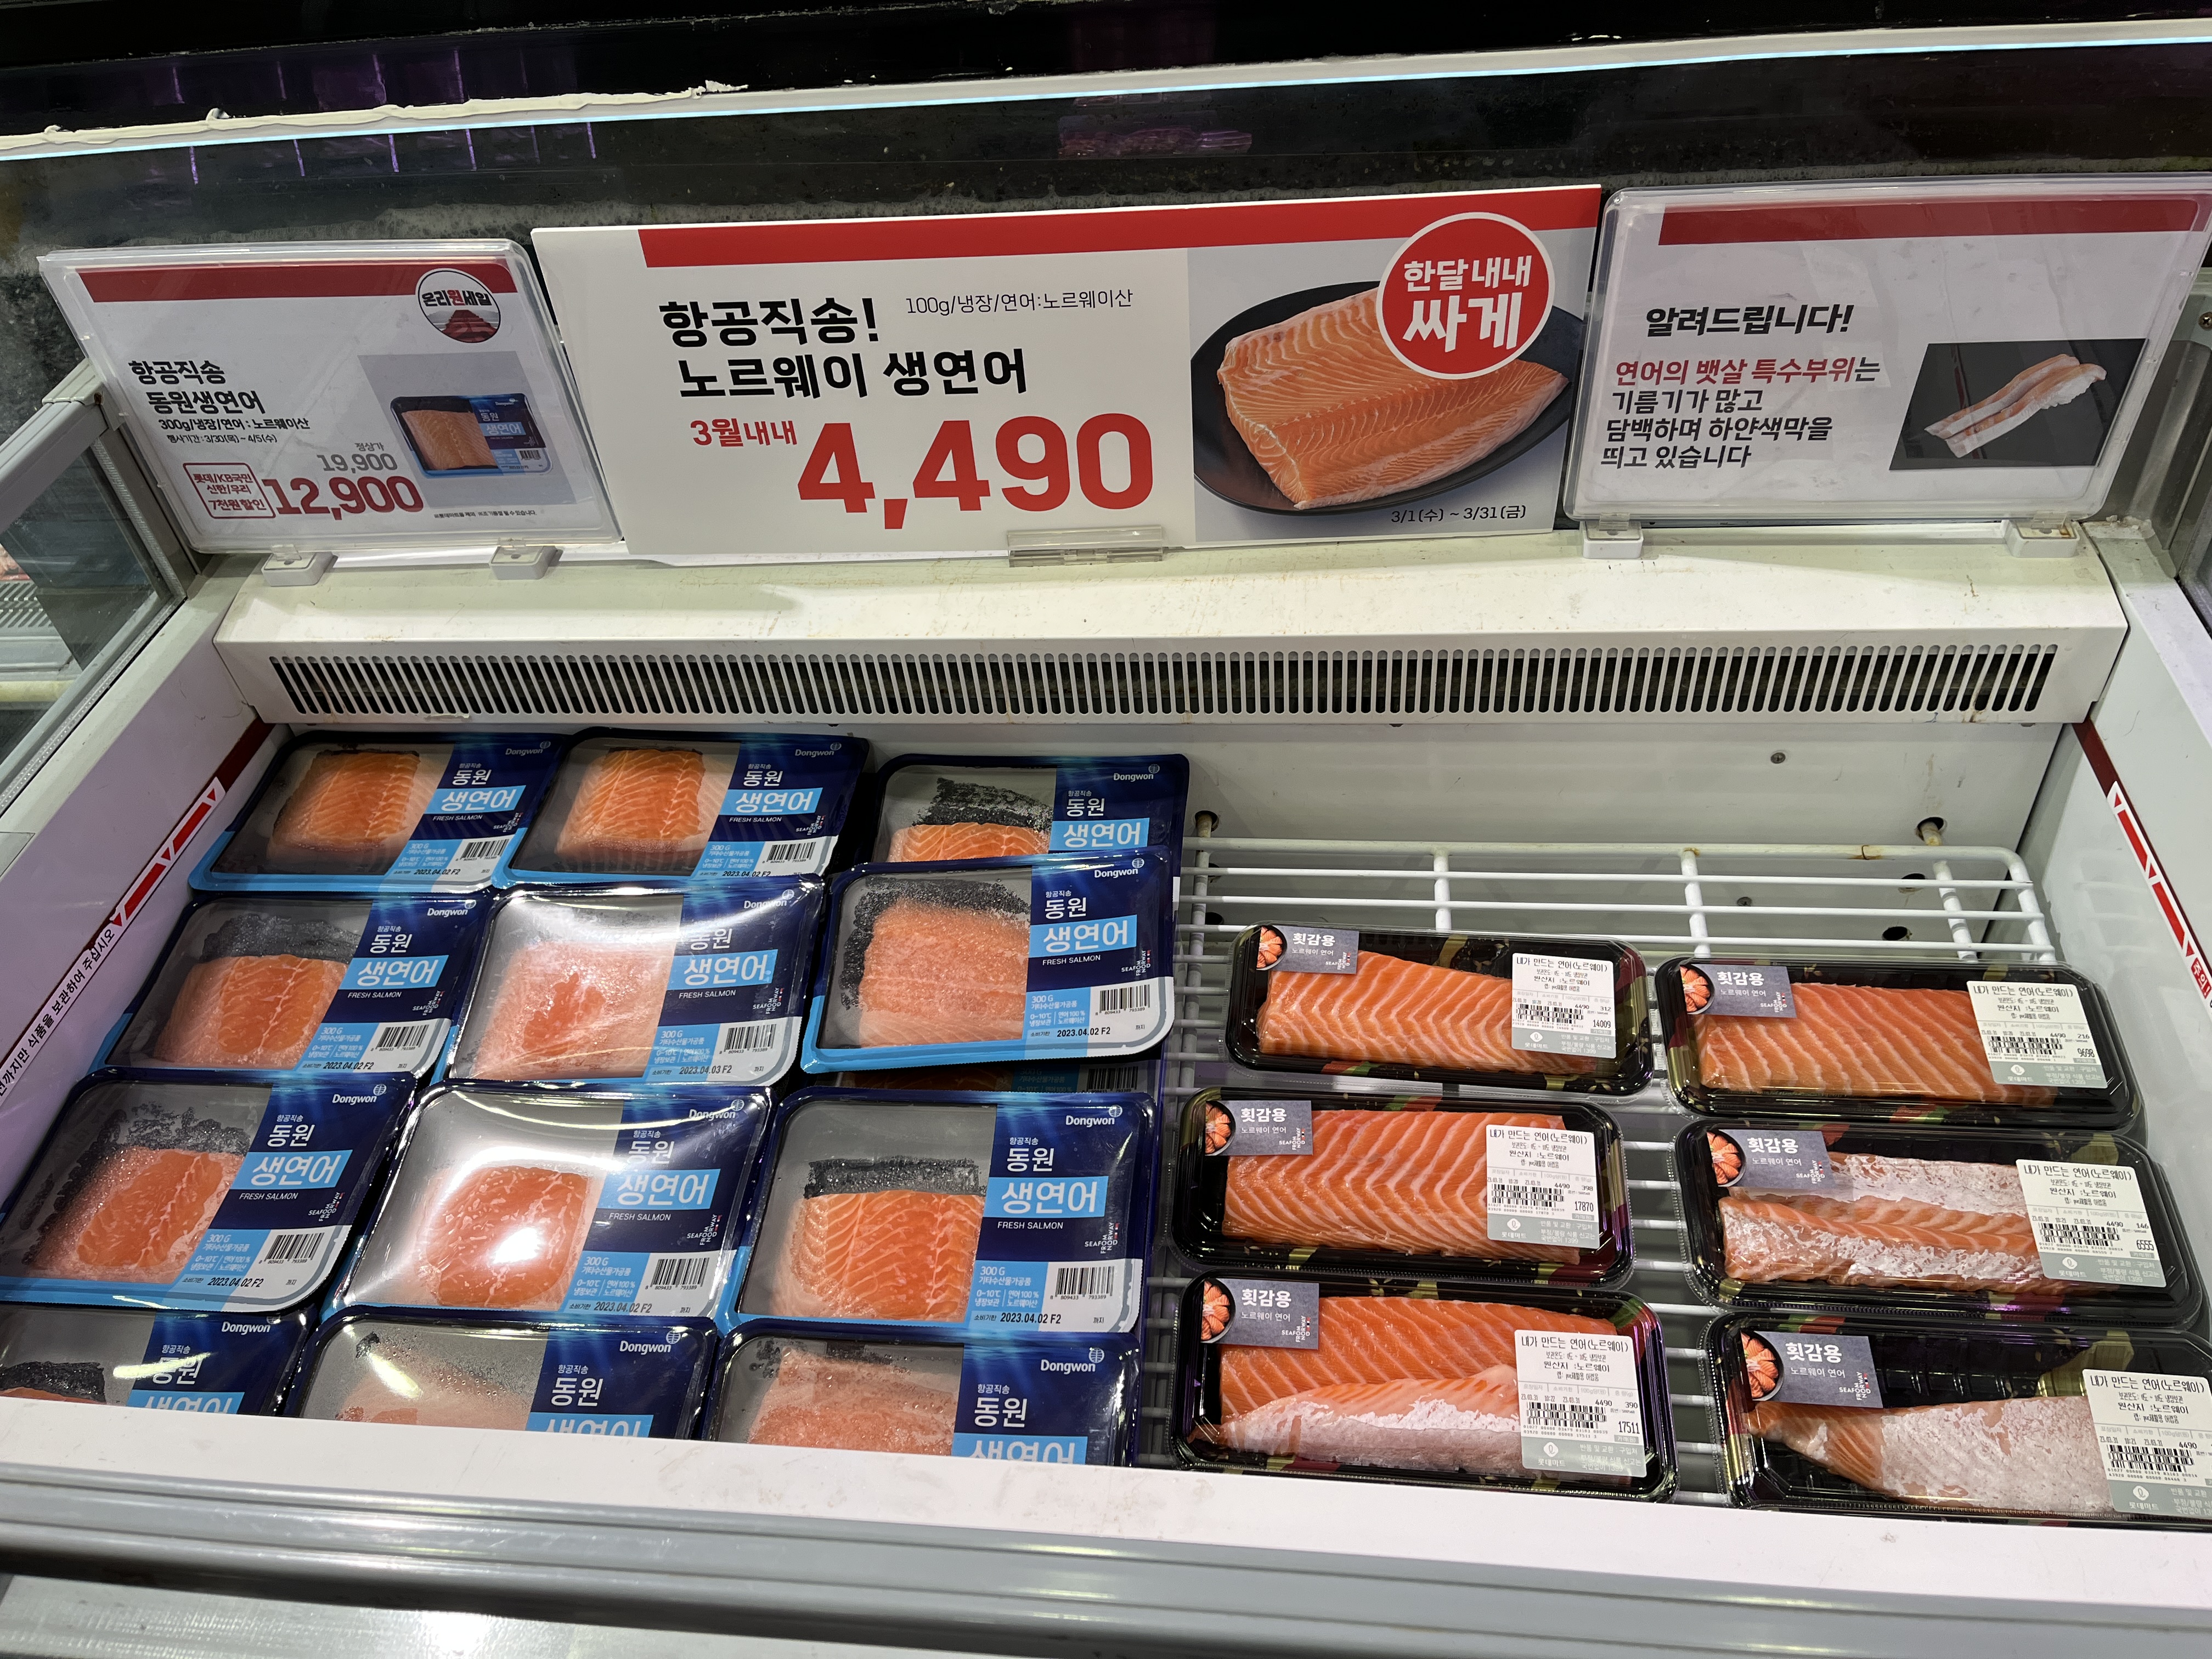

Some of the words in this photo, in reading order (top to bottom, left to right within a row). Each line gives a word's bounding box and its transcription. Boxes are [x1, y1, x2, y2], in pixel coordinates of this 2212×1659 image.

[658, 296, 879, 348] 항공직송!
[1402, 291, 1521, 353] 싸게
[1645, 303, 1855, 337] 알려드립니다!
[128, 360, 226, 385] 항공직송
[678, 352, 868, 399] 노르웨이
[882, 348, 1028, 396] 생연어
[1615, 360, 1689, 386] 연어의
[1695, 359, 1748, 386] 뱃살
[1751, 356, 1881, 384] 특수부위는
[145, 390, 266, 414] 동원생연어
[1611, 389, 1710, 415] 기름기가
[1714, 389, 1763, 414] 많고
[253, 418, 311, 430] 노르웨이산
[1606, 416, 1702, 442] 담백하며
[1708, 416, 1833, 441] 하얀색막을
[689, 418, 798, 448] 3월내내
[354, 443, 385, 452] 정상가
[317, 453, 398, 474] 19,900
[1600, 445, 1647, 470] 띄고
[1655, 444, 1752, 470] 있습니다
[797, 413, 1154, 531] 4,490
[207, 484, 252, 494] 신한/우리
[261, 476, 424, 521] 12,900
[1391, 507, 1444, 524] 3/1(수)
[1463, 505, 1527, 521] 3/31(금)
[505, 747, 544, 756] Dongwon
[794, 749, 835, 758] Dongwon
[452, 769, 492, 786] 동원
[743, 771, 783, 787] 동원
[1113, 772, 1154, 782] Dongwon
[441, 789, 516, 812] 생연어
[735, 791, 814, 814] 생연어
[1066, 797, 1105, 817] 동원
[1063, 822, 1141, 848] 생연어
[1094, 868, 1139, 879] Dongwon
[1045, 890, 1071, 898] 항공직송
[427, 908, 468, 918] Dongwon
[1045, 896, 1087, 920] 동원
[1043, 919, 1128, 953] 생연어
[1292, 932, 1336, 947] 횟감용
[370, 933, 413, 954] 동원
[1042, 958, 1066, 966] FRESH
[1069, 955, 1101, 964] SALMON
[357, 960, 439, 987] 생연어
[684, 954, 768, 986] 생연어
[1121, 963, 1151, 973] SEAFOOD
[1717, 972, 1764, 986] 횟감용
[28, 1013, 55, 1049] 식품을
[52, 968, 86, 1016] 보관하여
[82, 928, 115, 971] 주십시오
[704, 990, 736, 998] SALMON
[1593, 1019, 1611, 1029] 14009
[1057, 1028, 1099, 1037] 2023.04.02
[1101, 1026, 1111, 1035] F2
[2077, 1048, 2095, 1058] 9698
[679, 1066, 721, 1075] 2023.04.03
[722, 1065, 732, 1074] F2
[332, 1094, 377, 1105] Dongwon
[276, 1114, 304, 1122] 항공직송
[689, 1109, 736, 1121] Dongwon
[1065, 1115, 1115, 1128] Dongwon
[1240, 1108, 1287, 1123] 횟감용
[267, 1124, 315, 1147] 동원
[633, 1130, 662, 1139] 항공직송
[1009, 1137, 1039, 1146] 항공직송
[1489, 1129, 1504, 1138] 내가
[1508, 1130, 1531, 1141] 만드는
[626, 1140, 675, 1165] 동원
[1747, 1137, 1799, 1154] 횟감용
[1006, 1147, 1055, 1172] 동원
[1752, 1158, 1784, 1166] 노르웨이
[1785, 1158, 1802, 1167] 연어
[251, 1154, 342, 1187] 생연어
[2024, 1165, 2041, 1175] 내가
[2044, 1166, 2070, 1177] 만드는
[617, 1173, 710, 1206] 생연어
[1001, 1181, 1098, 1215] 생연어
[1574, 1200, 1594, 1212] 17870
[609, 1212, 636, 1221] FRESH
[636, 1212, 672, 1221] SALMON
[997, 1221, 1025, 1229] FRESH
[1027, 1221, 1064, 1230] SALMON
[1085, 1239, 1119, 1248] SEAFOOD
[2136, 1239, 2154, 1251] 6555
[980, 1266, 997, 1276] 300
[207, 1278, 251, 1288] 2023.04.02
[252, 1278, 264, 1288] F2
[1241, 1288, 1292, 1308] 횟감용
[594, 1302, 639, 1313] 2023.04.02
[640, 1303, 653, 1313] F2
[1000, 1312, 1048, 1323] 2023.04.02
[1050, 1314, 1061, 1324] F2
[1241, 1311, 1273, 1321] 노르웨이
[1274, 1313, 1291, 1323] 연어
[221, 1321, 272, 1335] Dongwon
[161, 1344, 190, 1354] 항공직송
[619, 1340, 672, 1355] Dongwon
[1521, 1336, 1538, 1347] 내가
[1541, 1336, 1566, 1350] 만드는
[1785, 1342, 1842, 1364] 횟감용
[557, 1364, 589, 1375] 항공직송
[1040, 1359, 1096, 1375] Dongwon
[1543, 1361, 1568, 1370] 원산지
[1790, 1367, 1825, 1378] 노르웨이
[1827, 1369, 1846, 1379] 연어
[977, 1384, 1011, 1395] 항공직송
[2090, 1375, 2108, 1387] 내가
[2111, 1376, 2139, 1390] 만드는
[550, 1377, 603, 1407] 동원
[1595, 1398, 1613, 1407] 4490
[974, 1396, 1028, 1428] 동원
[1618, 1421, 1640, 1434] 17511
